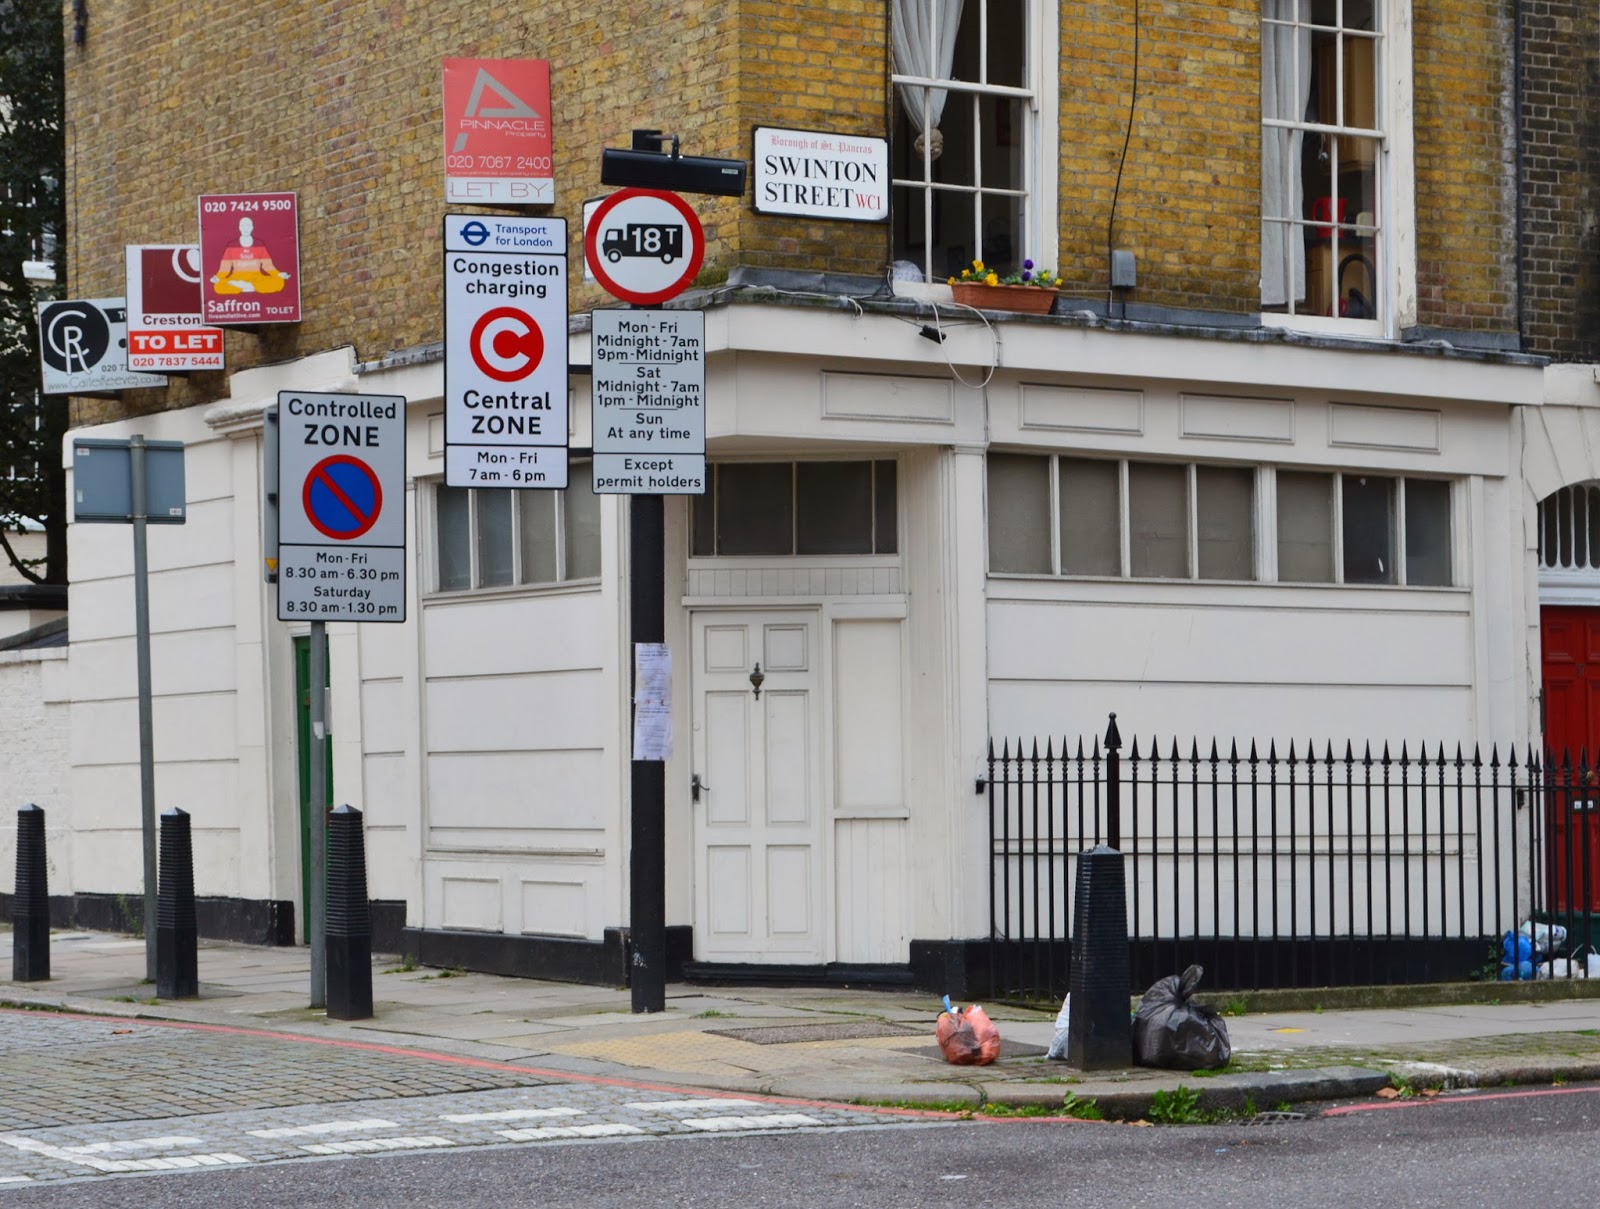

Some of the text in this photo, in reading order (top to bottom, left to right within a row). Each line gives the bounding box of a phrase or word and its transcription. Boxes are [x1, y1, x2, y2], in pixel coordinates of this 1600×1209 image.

[461, 120, 544, 130] PINNACLE
[506, 130, 546, 138] Property
[771, 135, 873, 154] Borough of St. Pancras
[448, 155, 550, 169] 020 7067 2400
[765, 155, 877, 183] SWINTON
[452, 182, 548, 198] LET BY
[765, 182, 880, 210] STREET WC1
[204, 200, 291, 212] 020 7424 9500
[495, 224, 547, 235] Transport
[496, 236, 552, 246] for London
[454, 258, 559, 277] Congestion
[466, 279, 546, 298] charging
[208, 300, 260, 312] Saffron
[279, 306, 294, 314] LET
[118, 310, 127, 319] T
[134, 335, 218, 350] TO LET
[598, 335, 660, 348] Midnight
[671, 336, 698, 347] 7am
[133, 357, 220, 366] 020 7837 5444
[637, 367, 661, 378] Sat
[598, 381, 660, 394] Midnight
[671, 381, 699, 392] 7am
[464, 390, 551, 410] Central
[598, 395, 625, 407] 1pm
[637, 395, 699, 408] Midnight
[288, 398, 396, 419] Controlled
[636, 413, 662, 424] Sun
[472, 416, 541, 435] ZONE
[304, 424, 379, 447] ZONE
[607, 427, 690, 441] At any time
[624, 459, 673, 472] Except
[597, 476, 701, 488] permit holders
[285, 568, 316, 578] 8.30
[381, 572, 399, 582] pm
[314, 586, 371, 599] Saturday
[286, 602, 317, 613] 8.30
[379, 605, 397, 615] pm
